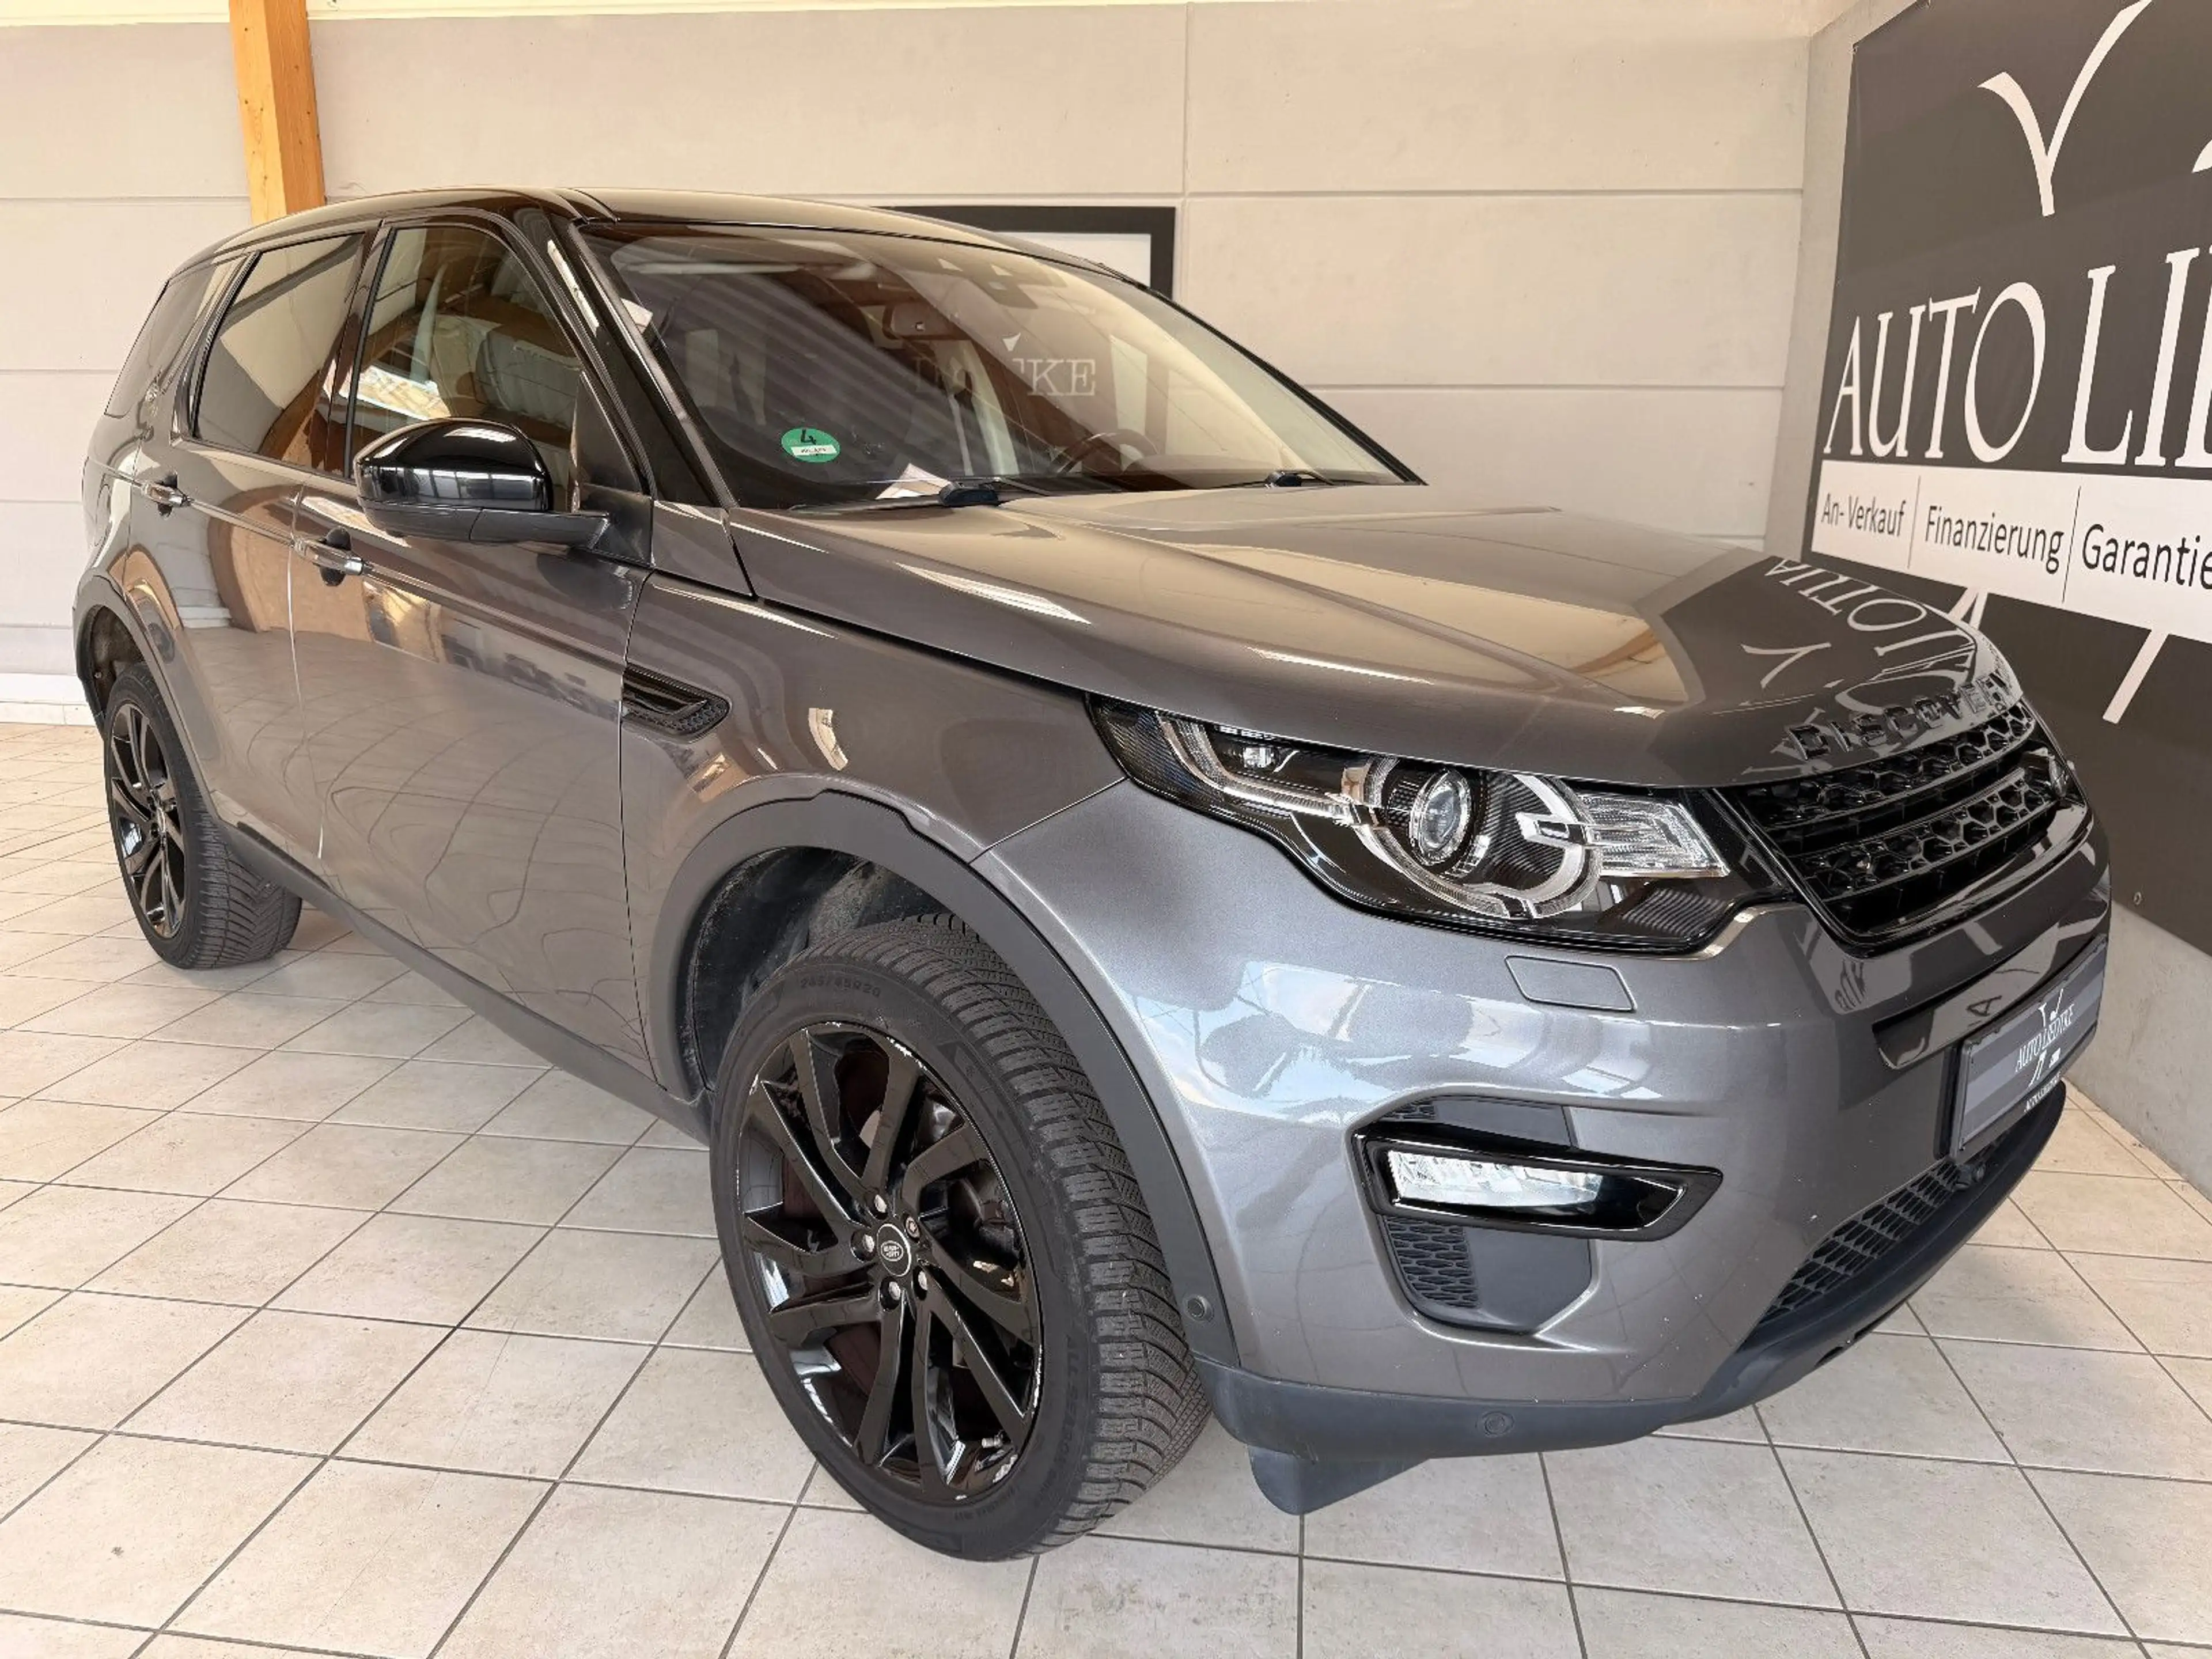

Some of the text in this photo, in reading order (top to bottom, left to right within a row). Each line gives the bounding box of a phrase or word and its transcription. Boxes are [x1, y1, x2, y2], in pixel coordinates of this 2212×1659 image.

[1823, 281, 2046, 463] AUTO
[800, 428, 817, 445] 4
[1848, 494, 1907, 537] Verkauf
[1925, 505, 2065, 574] Finanzierung
[2082, 523, 2212, 590] Garantie
[2015, 1032, 2041, 1073] AUTO
